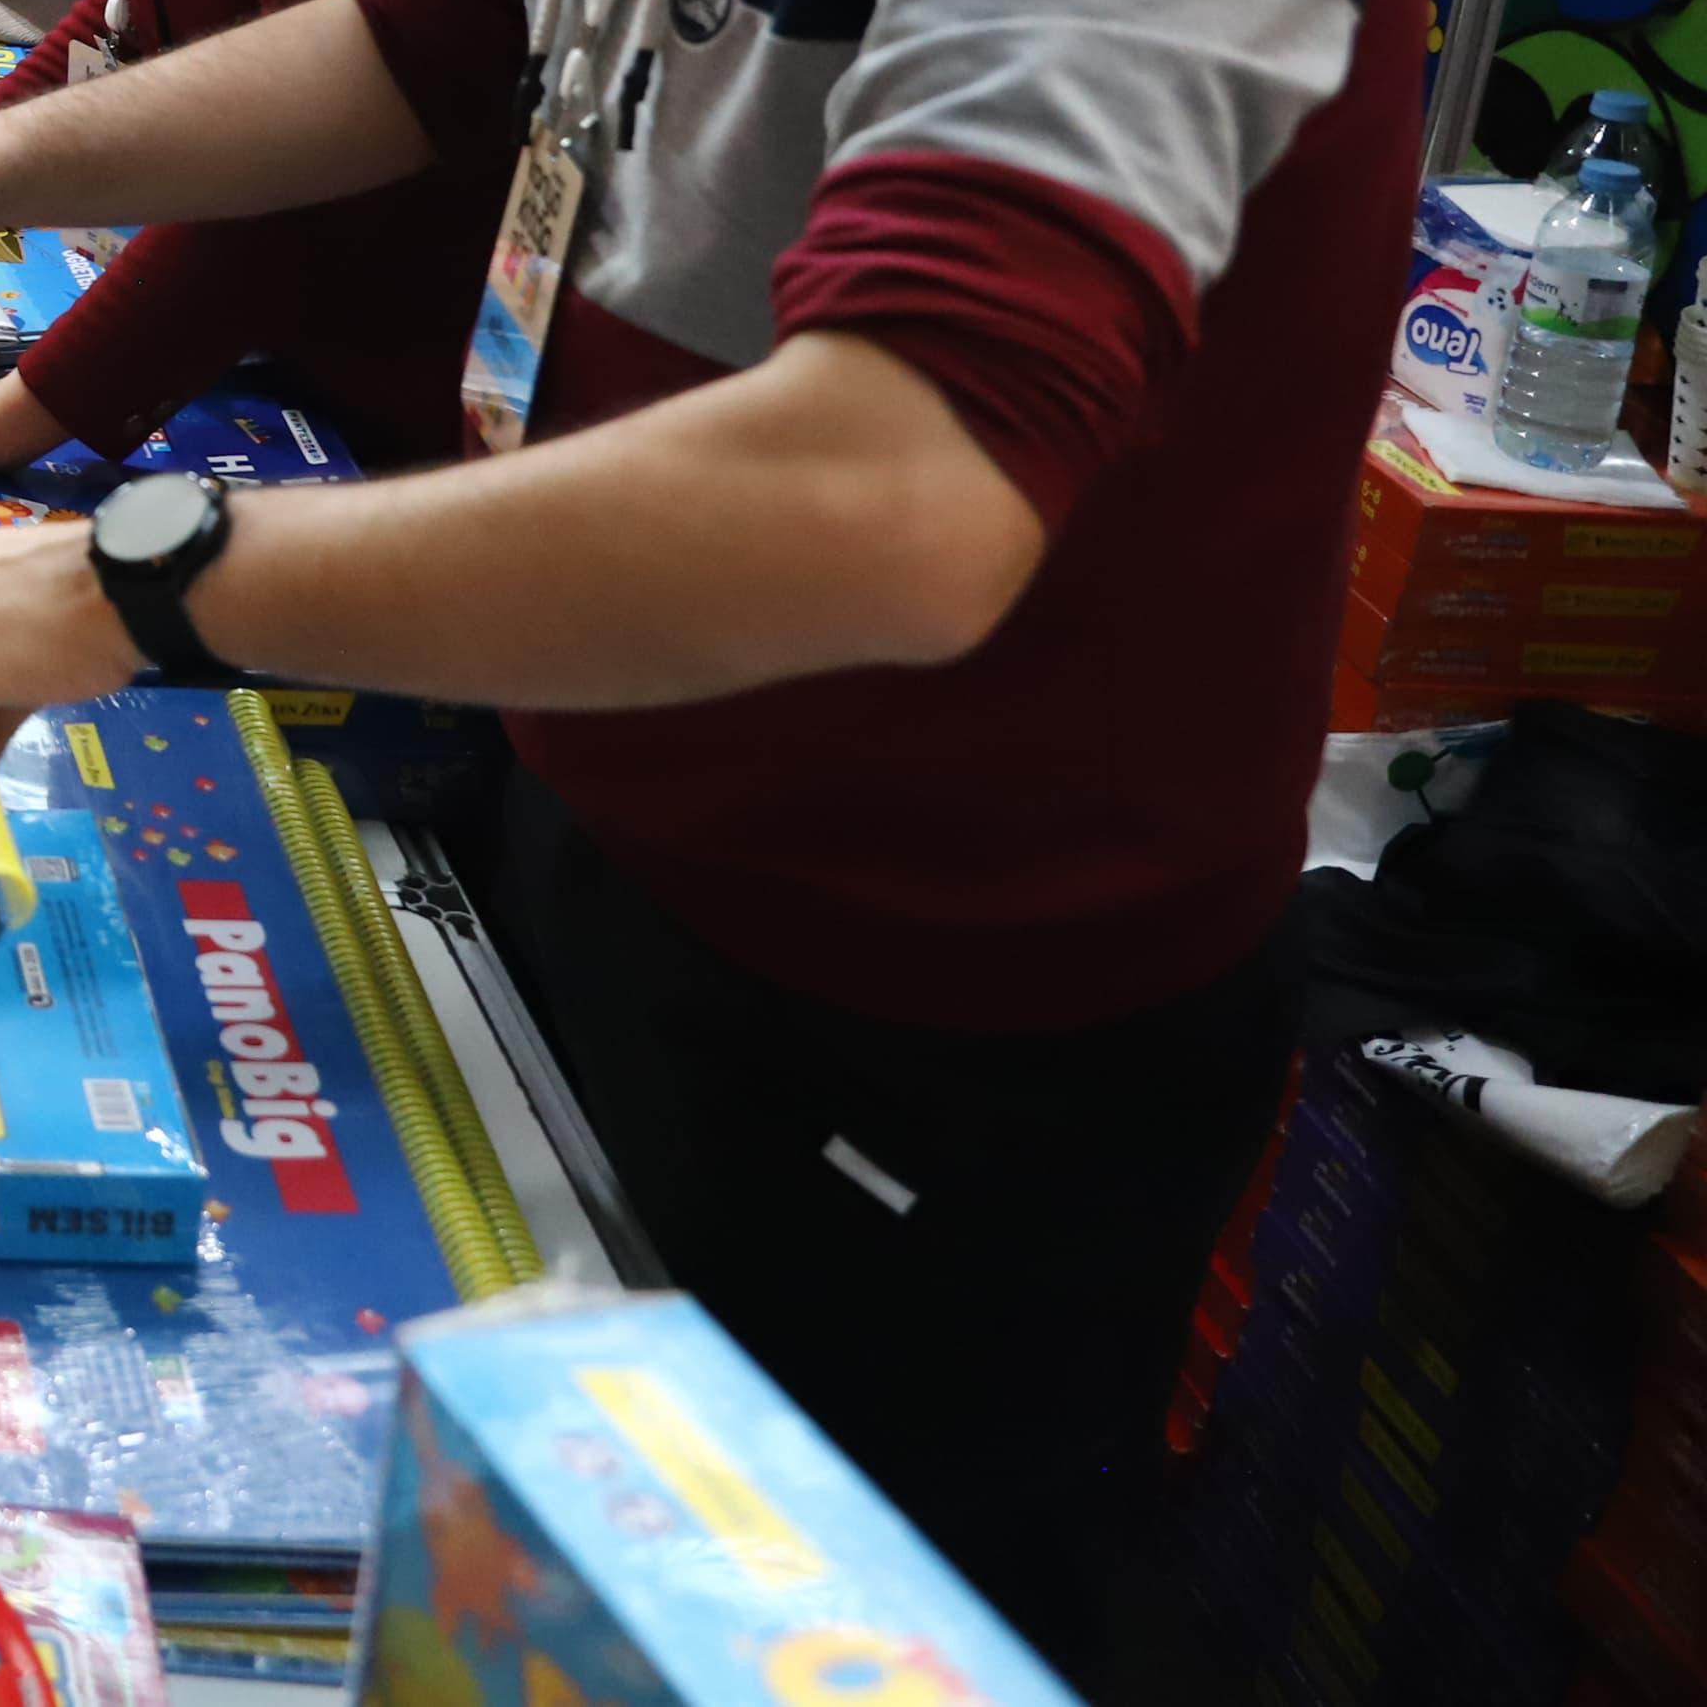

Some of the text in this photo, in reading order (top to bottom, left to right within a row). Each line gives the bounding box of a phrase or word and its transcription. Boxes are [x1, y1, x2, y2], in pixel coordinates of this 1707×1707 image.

[1410, 313, 1482, 376] Teno
[182, 916, 339, 1160] PanoBig
[26, 1205, 176, 1242] BİLSEM
